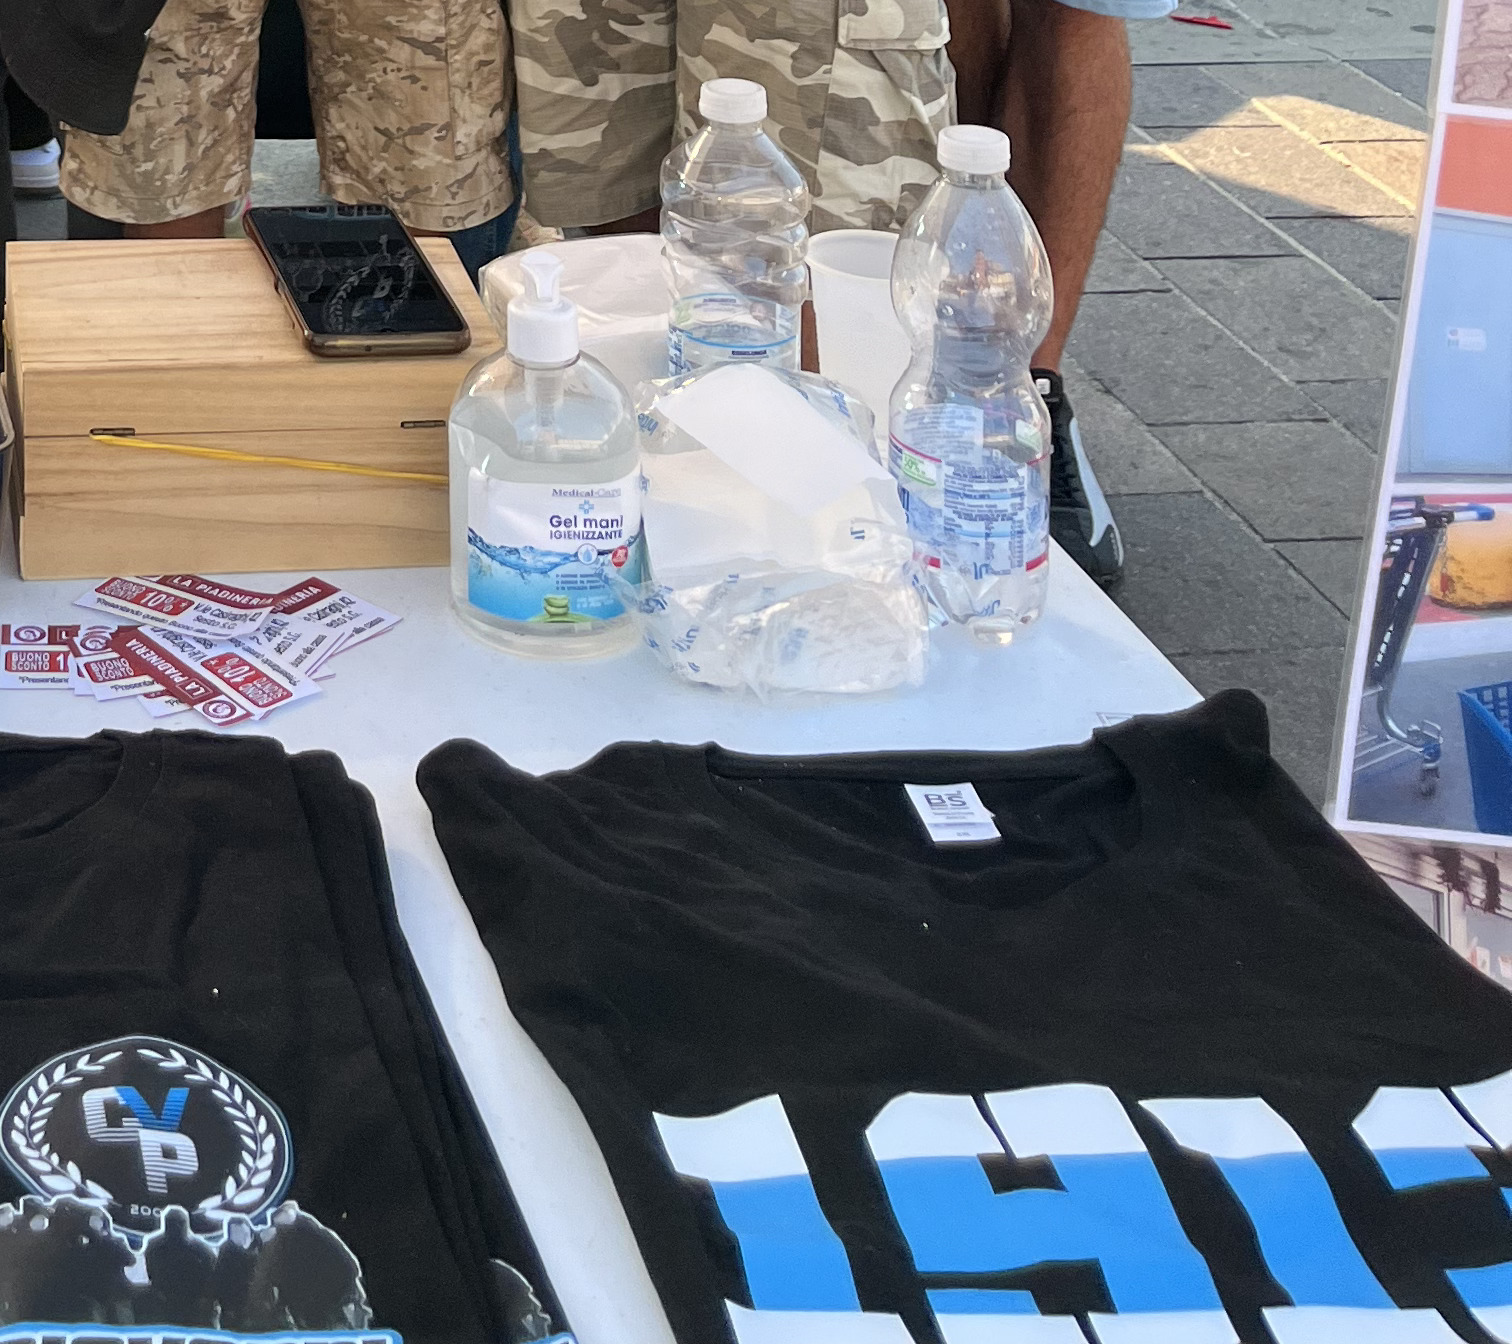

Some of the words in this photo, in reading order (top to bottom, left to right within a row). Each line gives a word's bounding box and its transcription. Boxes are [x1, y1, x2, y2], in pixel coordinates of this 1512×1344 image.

[549, 514, 579, 529] Gel
[583, 514, 624, 529] mani
[549, 529, 623, 541] IGIENIZZANTE
[172, 575, 193, 588] LA
[196, 583, 274, 606] PIADINERIA
[11, 651, 50, 662] BUONO
[124, 638, 189, 684] PIADINERIA
[11, 661, 50, 672] SCONTO
[90, 656, 131, 673] BUONO
[96, 667, 136, 682] SCONTO
[184, 680, 206, 697] LA
[82, 1085, 199, 1194] CVP
[130, 1203, 162, 1218] 200
